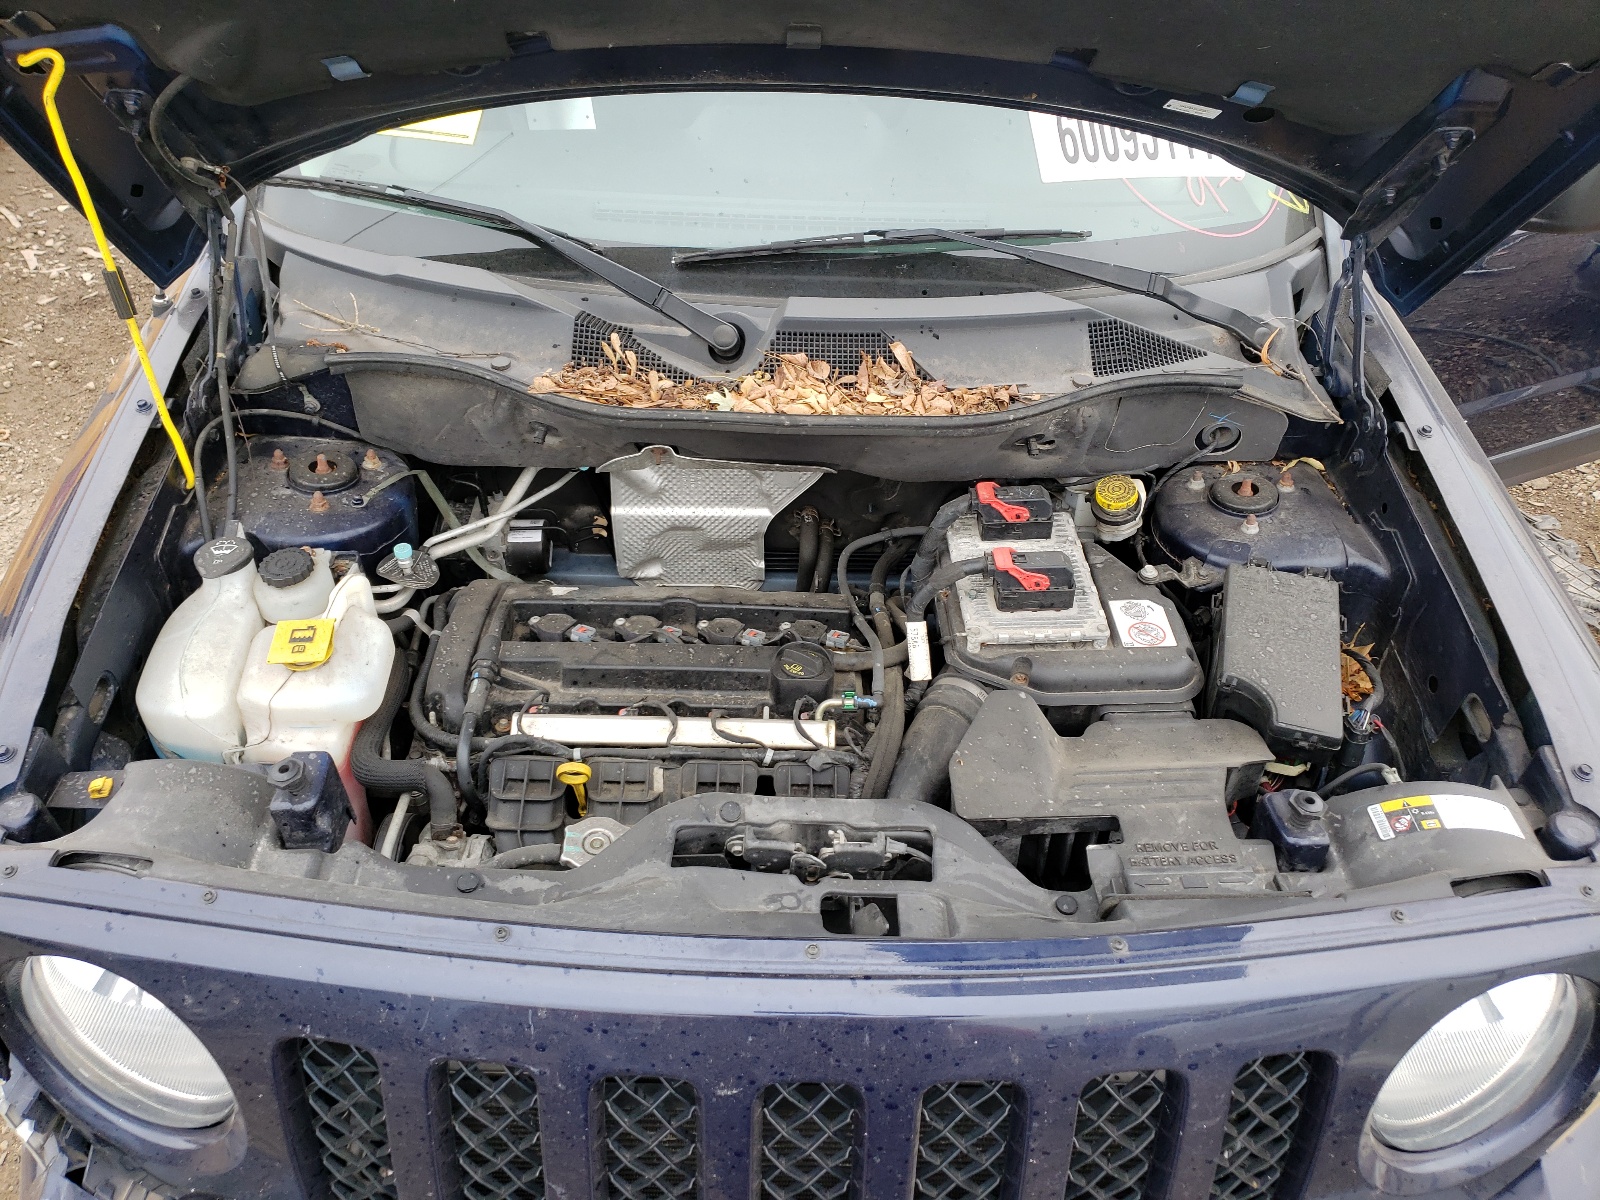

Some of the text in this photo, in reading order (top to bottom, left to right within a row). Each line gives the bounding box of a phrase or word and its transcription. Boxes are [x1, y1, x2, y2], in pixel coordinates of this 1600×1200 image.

[1135, 840, 1219, 852] REMOVE FOR
[1129, 853, 1238, 867] BATTERY ACCESS
